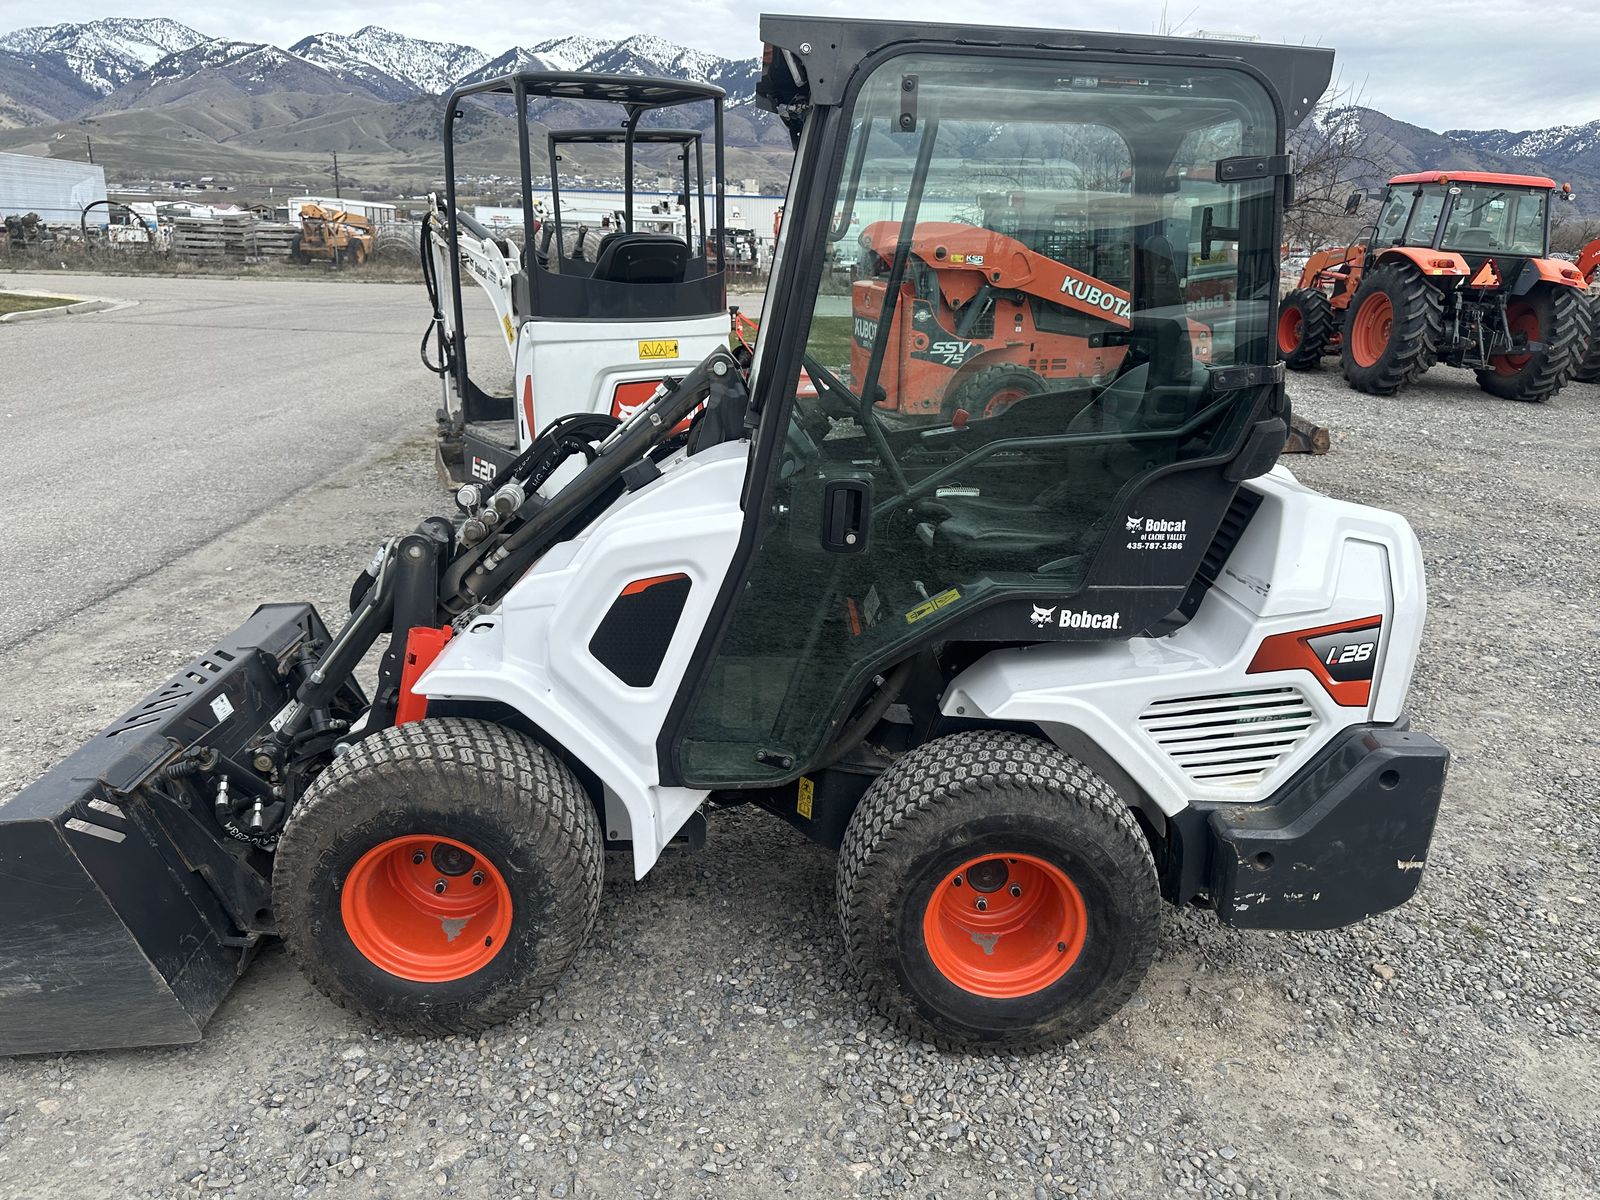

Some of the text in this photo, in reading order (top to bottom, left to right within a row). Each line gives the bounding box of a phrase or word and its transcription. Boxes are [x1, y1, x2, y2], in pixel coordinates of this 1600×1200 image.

[1060, 276, 1131, 319] KUBOTA
[930, 341, 972, 354] SSV
[943, 353, 965, 365] 75
[471, 456, 497, 481] E20
[1145, 519, 1187, 532] Bobcat
[1148, 533, 1165, 541] CACHE
[1166, 533, 1187, 541] VALLEY
[1126, 542, 1183, 550] 435-787-1586
[1059, 609, 1120, 630] Bobcat
[1326, 642, 1374, 665] L28
